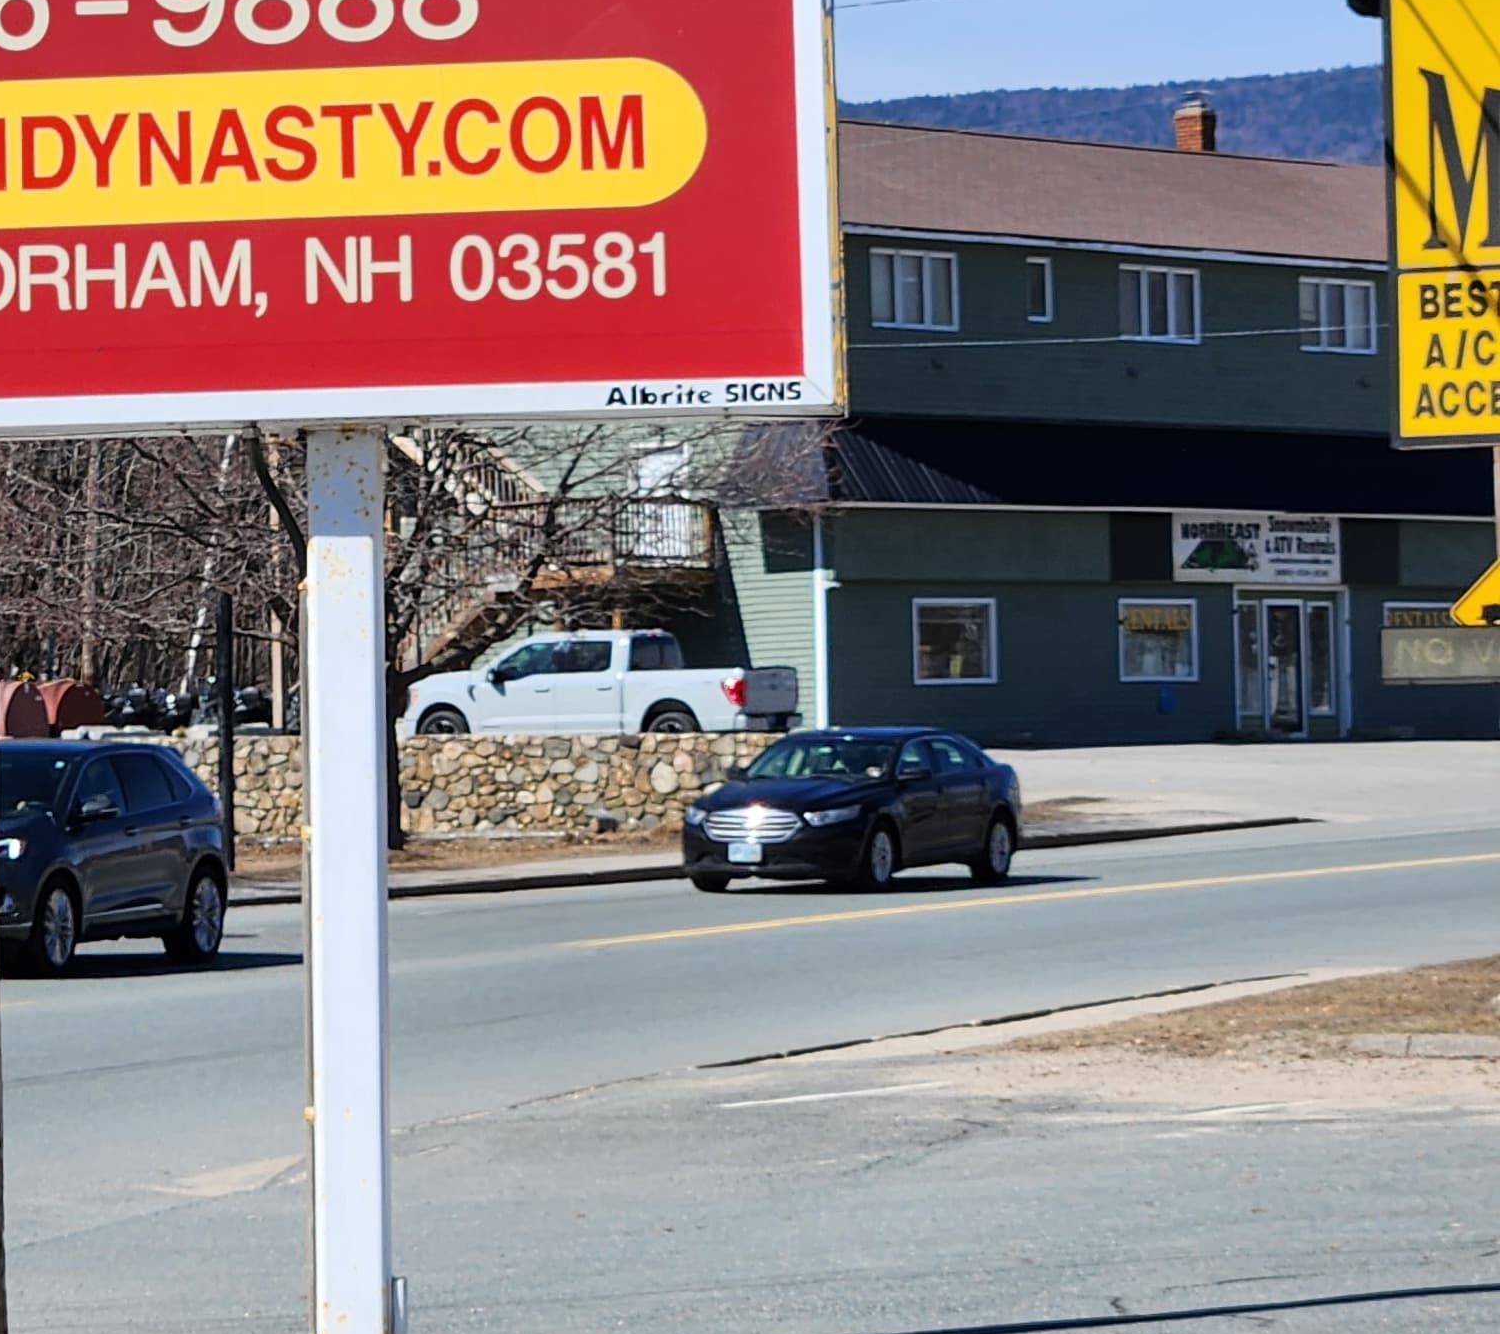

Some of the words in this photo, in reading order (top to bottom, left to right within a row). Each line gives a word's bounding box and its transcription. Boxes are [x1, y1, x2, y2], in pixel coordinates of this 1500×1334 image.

[305, 235, 413, 305] NH
[450, 231, 667, 302] 03581
[1424, 329, 1496, 369] A/C
[605, 384, 712, 407] Albrite
[725, 381, 802, 403] SIGNS
